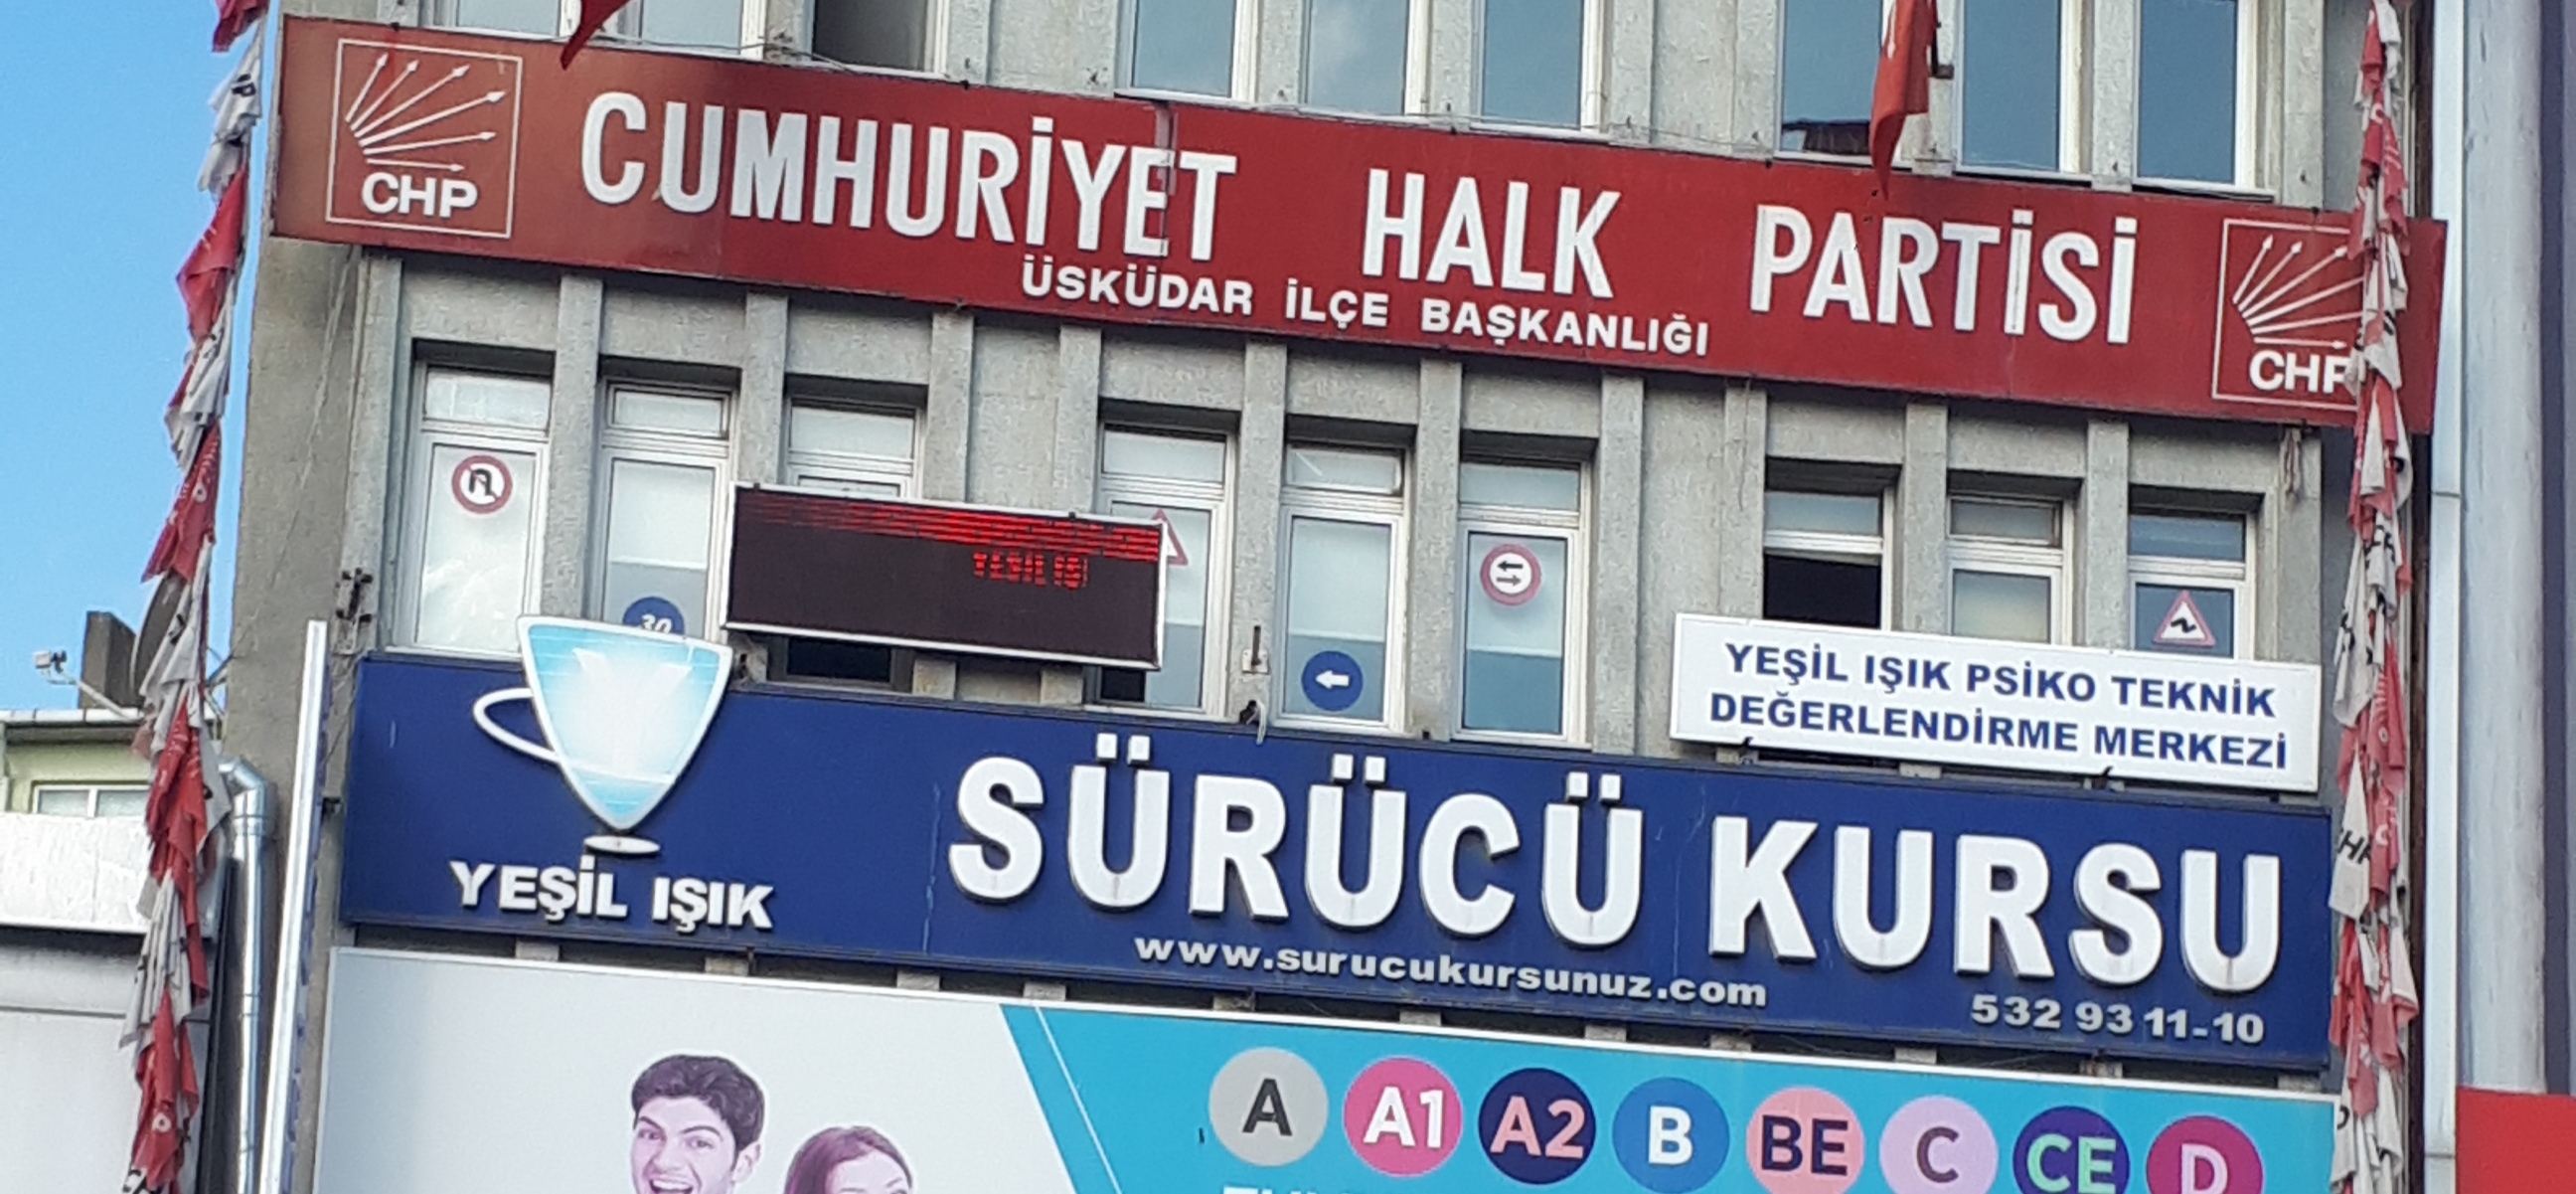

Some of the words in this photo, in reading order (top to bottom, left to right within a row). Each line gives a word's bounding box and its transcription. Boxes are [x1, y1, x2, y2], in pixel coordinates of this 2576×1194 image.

[361, 171, 479, 219] CHP
[580, 90, 1238, 262] CUMHURİYET
[1362, 167, 1622, 299] HALK
[1750, 203, 2138, 345] PARTİSİ
[1021, 254, 1253, 317] ÜSKÜDAR
[1284, 277, 1389, 331] İLÇE
[1420, 296, 1709, 358] BAŞKANLIĞI
[1724, 641, 1850, 686] YEŞİL
[1863, 653, 1952, 696] IŞIK
[1967, 660, 2097, 702] PSİKO
[2112, 676, 2277, 719] TEKNİK
[1709, 691, 2079, 752] DEĞERLENDİRME
[2094, 724, 2287, 769] MERKEZİ
[449, 854, 628, 922] YEŞİL
[652, 876, 774, 934] IŞIK
[948, 732, 1645, 949] SÜRÜCÜ
[1708, 814, 2282, 994] KURSU
[1133, 937, 1767, 1007] www.surucukursunuz.com
[1971, 994, 2062, 1030] 532
[2075, 1002, 2134, 1035] 93
[2144, 1006, 2264, 1044] 11-10
[1241, 1078, 1293, 1137] A
[1363, 1086, 1444, 1149] A1
[1490, 1095, 1585, 1160] A2
[1647, 1106, 1692, 1166] B
[1760, 1113, 1850, 1177] BE
[1916, 1125, 1960, 1184] C
[2026, 1132, 2118, 1194] CE
[2180, 1143, 2229, 1194] D
